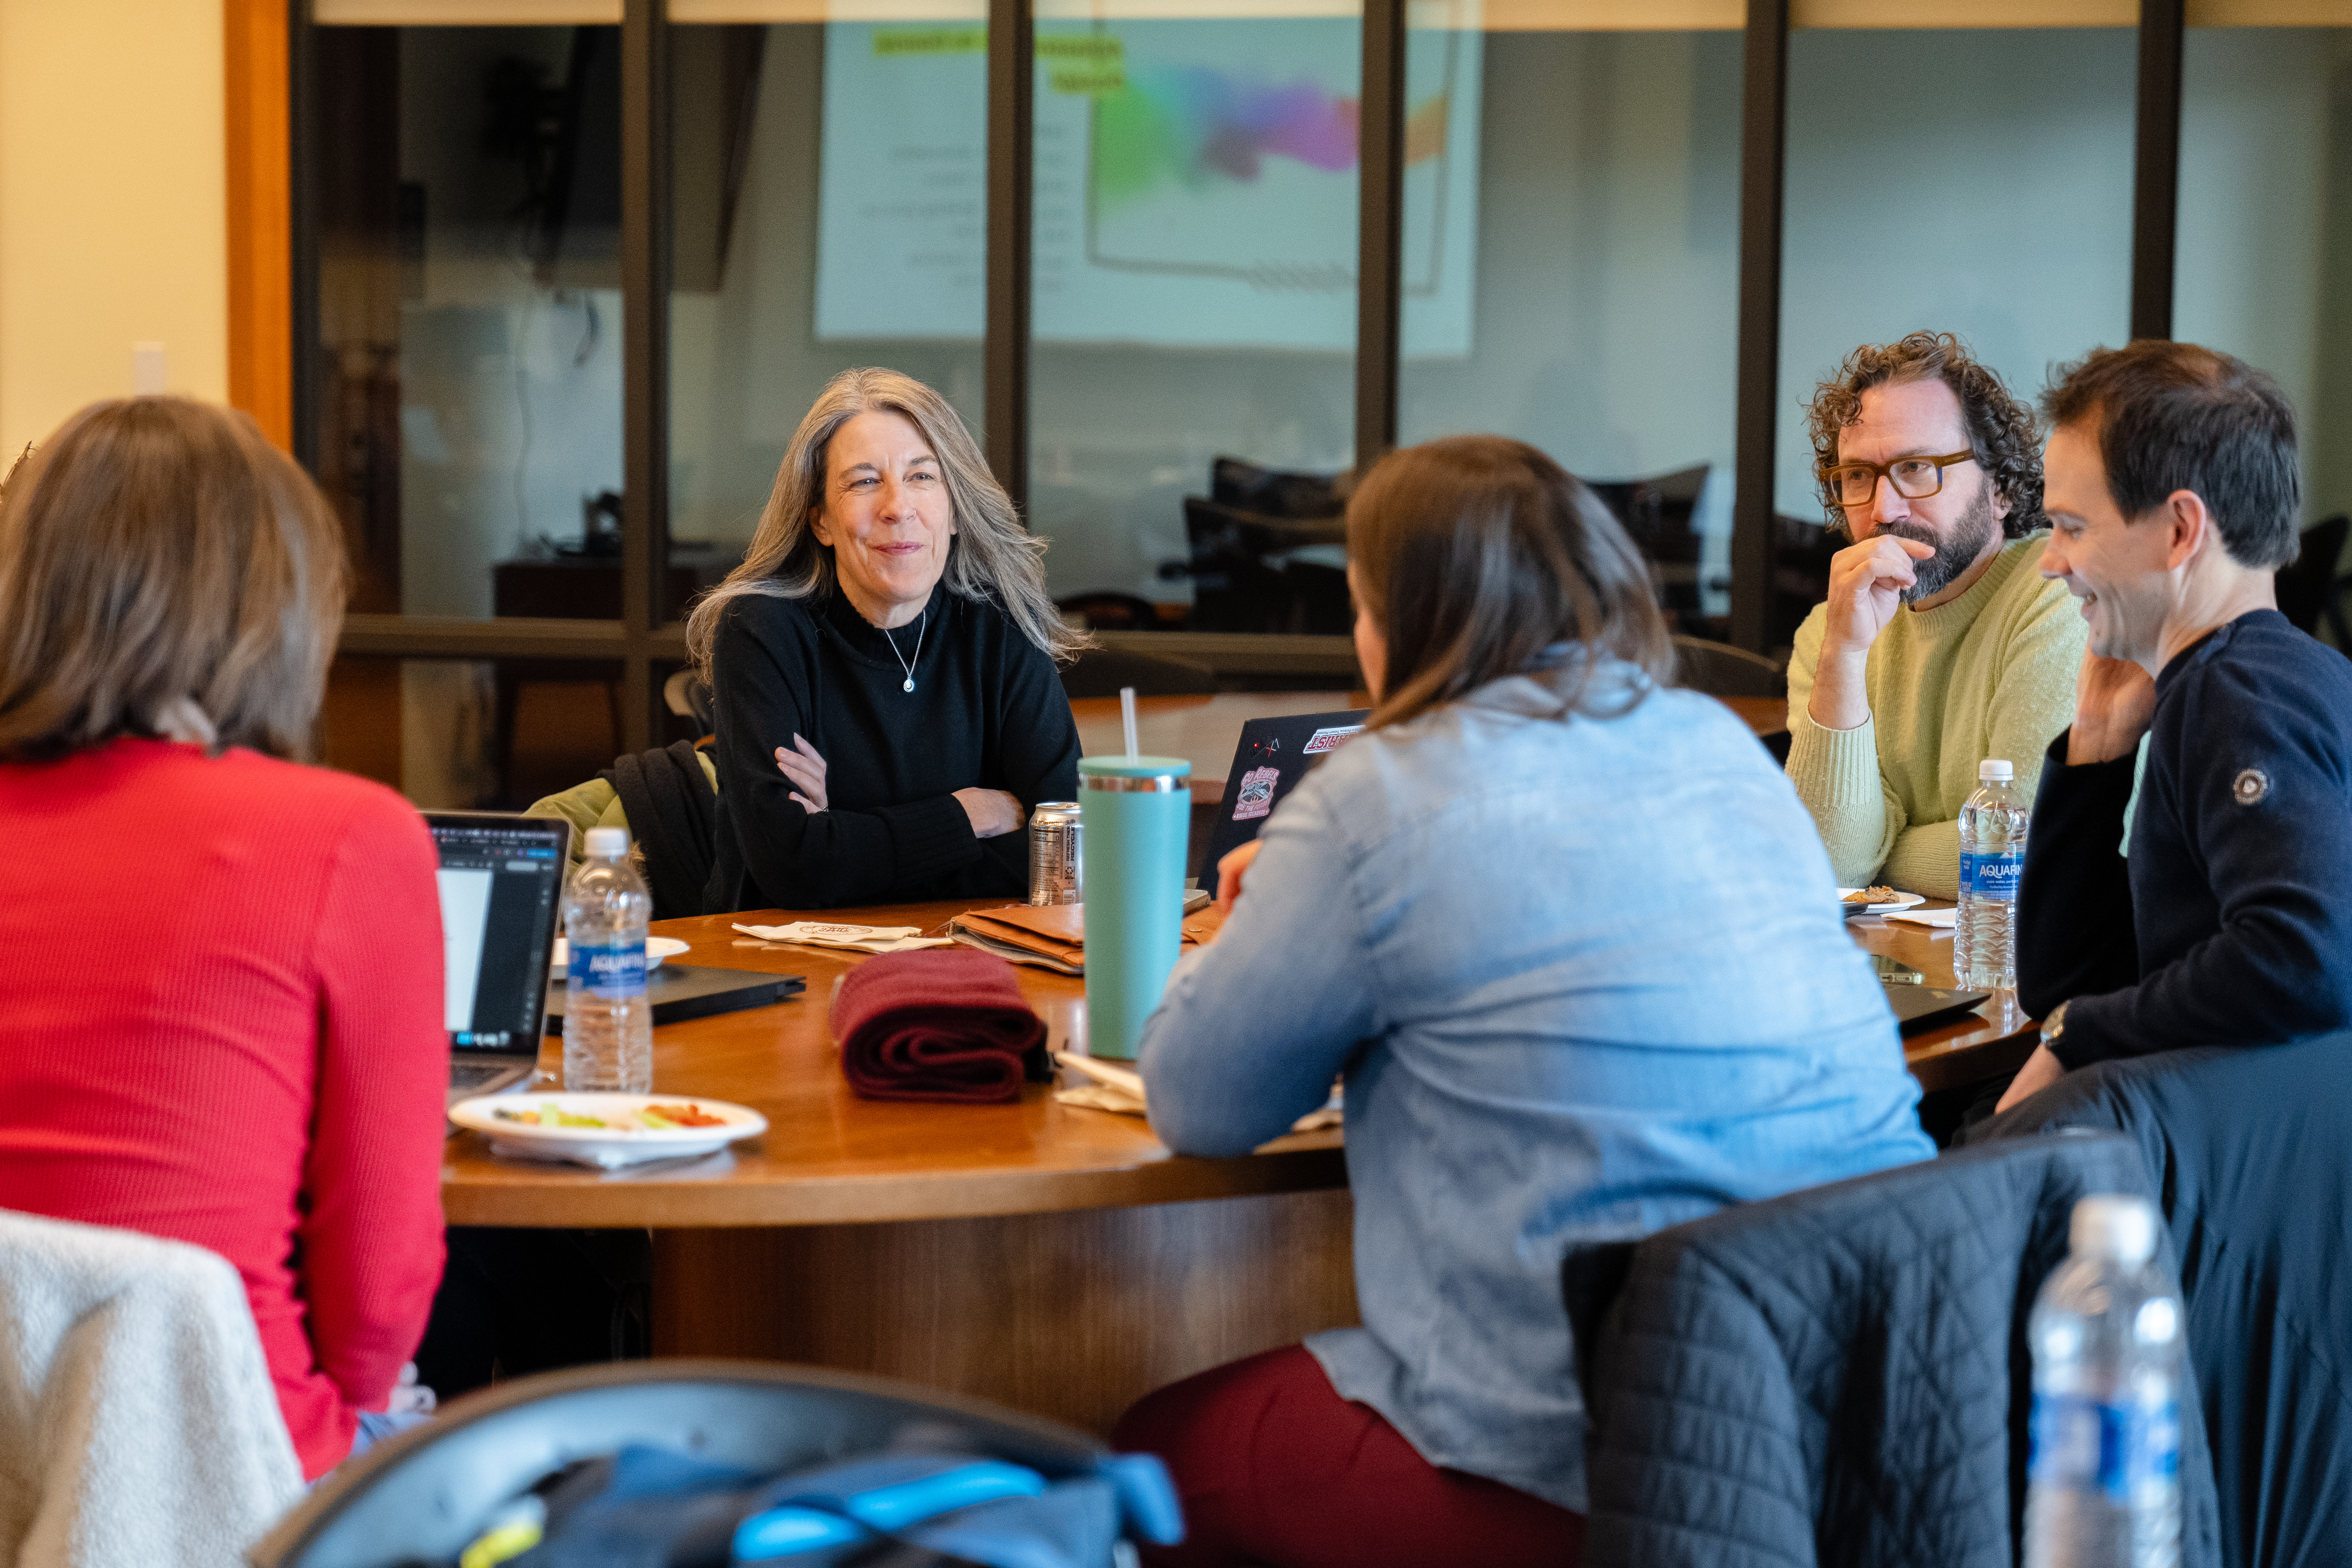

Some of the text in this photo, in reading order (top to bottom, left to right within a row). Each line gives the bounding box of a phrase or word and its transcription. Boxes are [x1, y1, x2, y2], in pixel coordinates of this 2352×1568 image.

[1307, 734, 1349, 750] ARIST
[1242, 768, 1278, 785] GO REBELS
